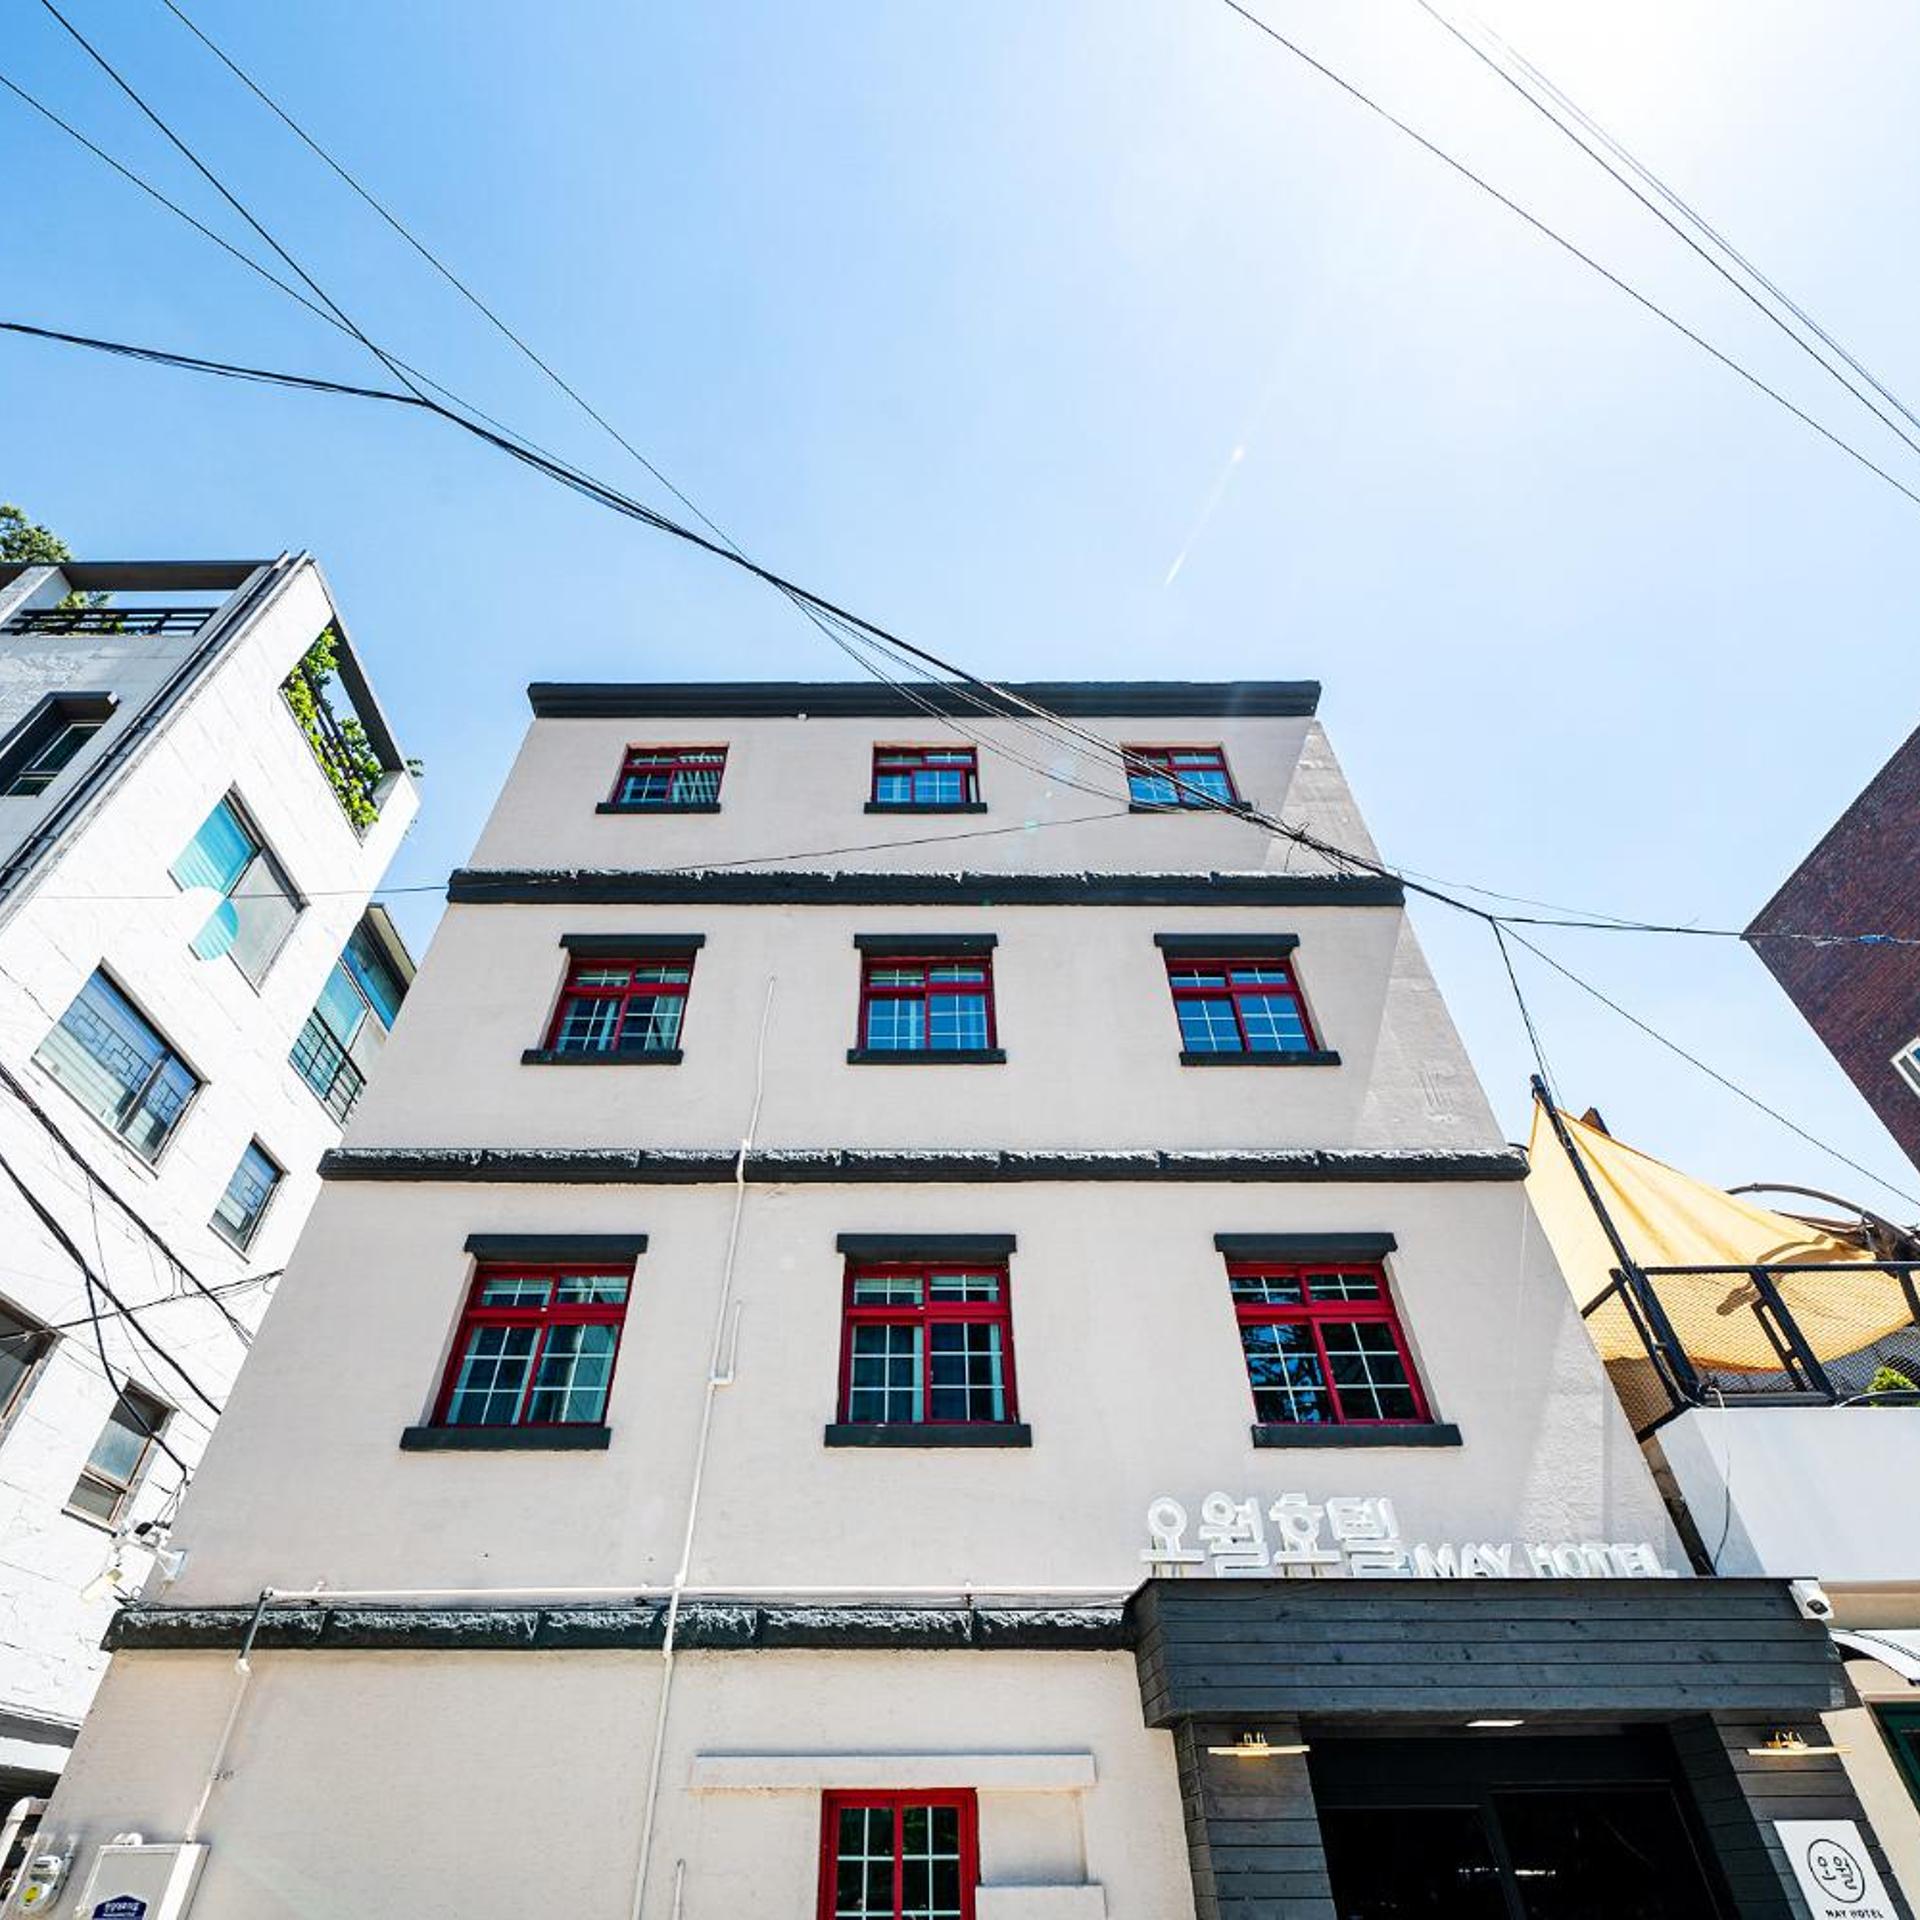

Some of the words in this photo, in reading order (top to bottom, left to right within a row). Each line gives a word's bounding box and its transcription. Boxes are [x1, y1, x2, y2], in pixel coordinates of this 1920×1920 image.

[1140, 1491, 1414, 1579] 오월호텔
[1413, 1543, 1512, 1578] MAY
[1525, 1543, 1679, 1578] HOTEL
[1825, 1909, 1847, 1919] MAY
[1850, 1909, 1884, 1919] HOTEL
